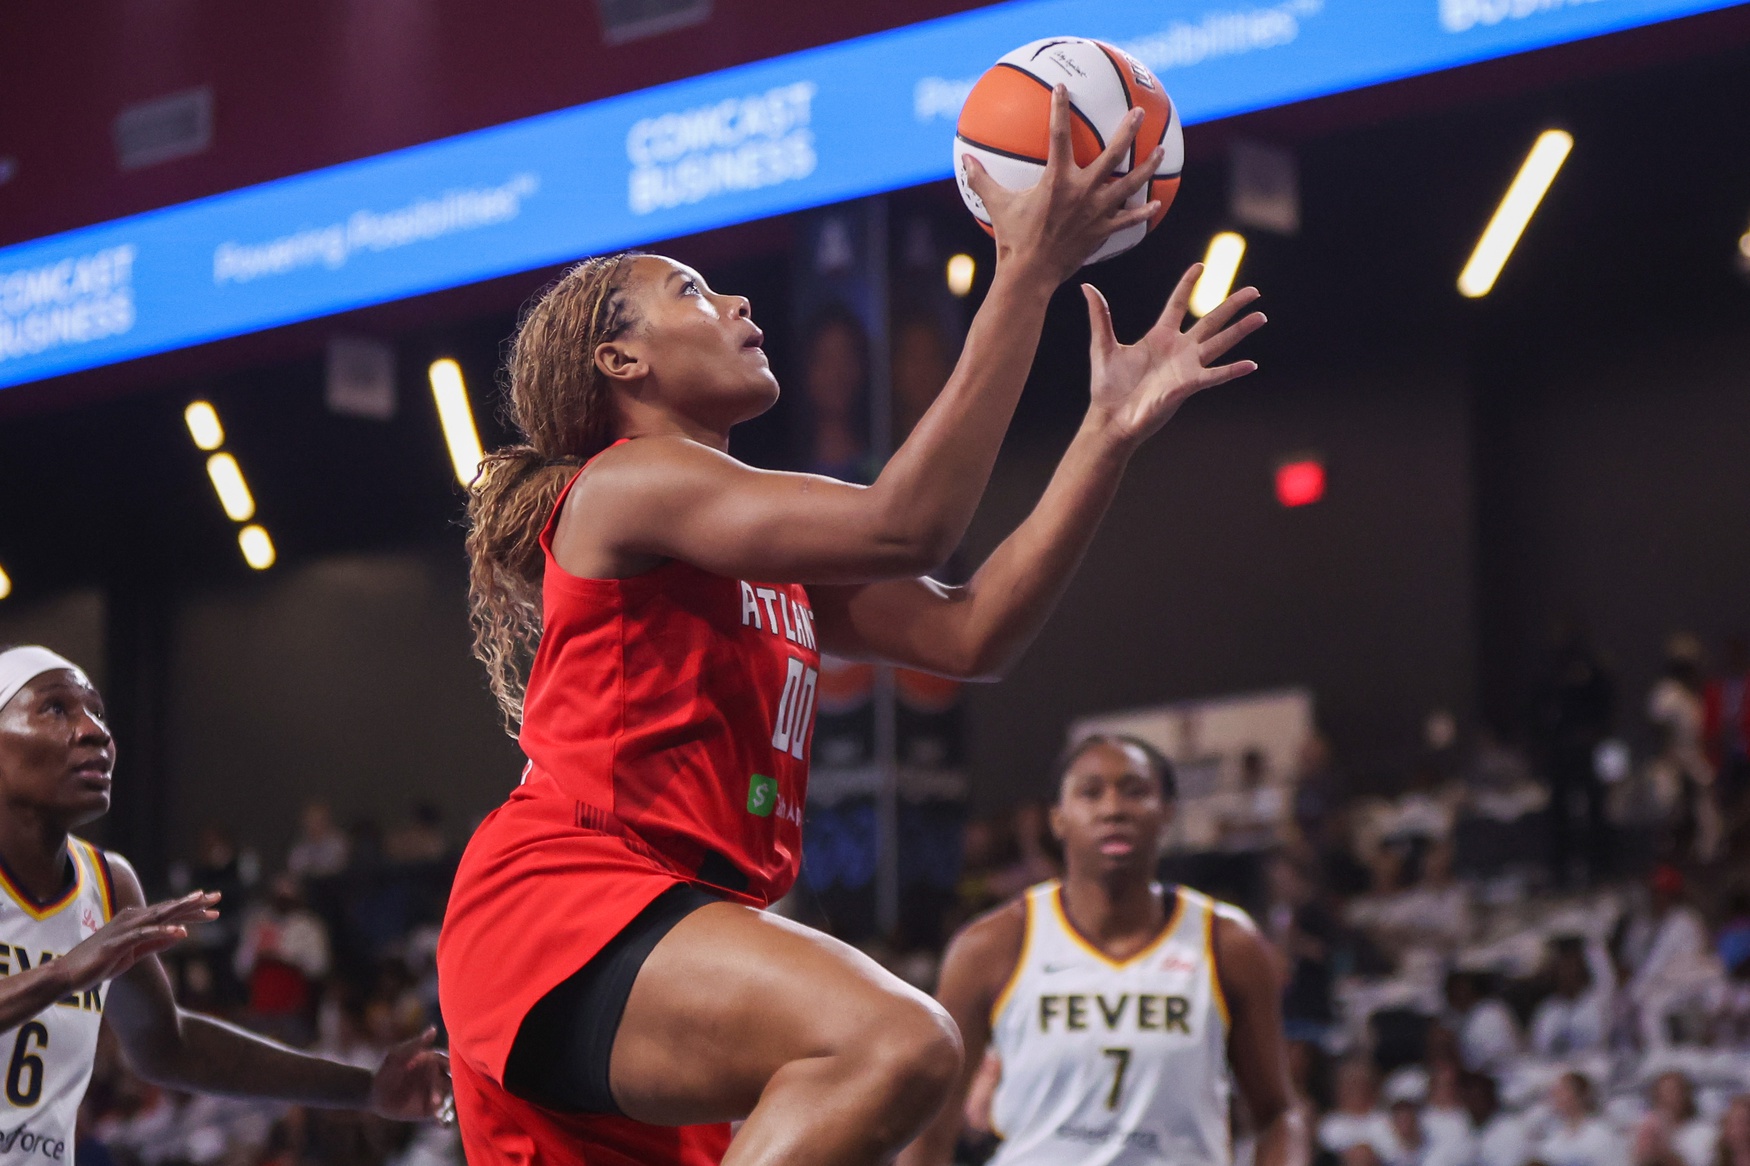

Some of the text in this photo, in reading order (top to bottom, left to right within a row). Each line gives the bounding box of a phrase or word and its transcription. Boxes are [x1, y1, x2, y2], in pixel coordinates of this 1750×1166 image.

[627, 80, 818, 164] COMCAST
[628, 127, 817, 215] BUSINESS
[0, 244, 136, 314] OMCAST
[0, 286, 137, 360] USINESS
[740, 579, 817, 651] ATLAN
[772, 656, 819, 761] 00
[1038, 993, 1192, 1035] FEVER
[5, 1019, 49, 1109] 6
[1102, 1047, 1131, 1110] 7
